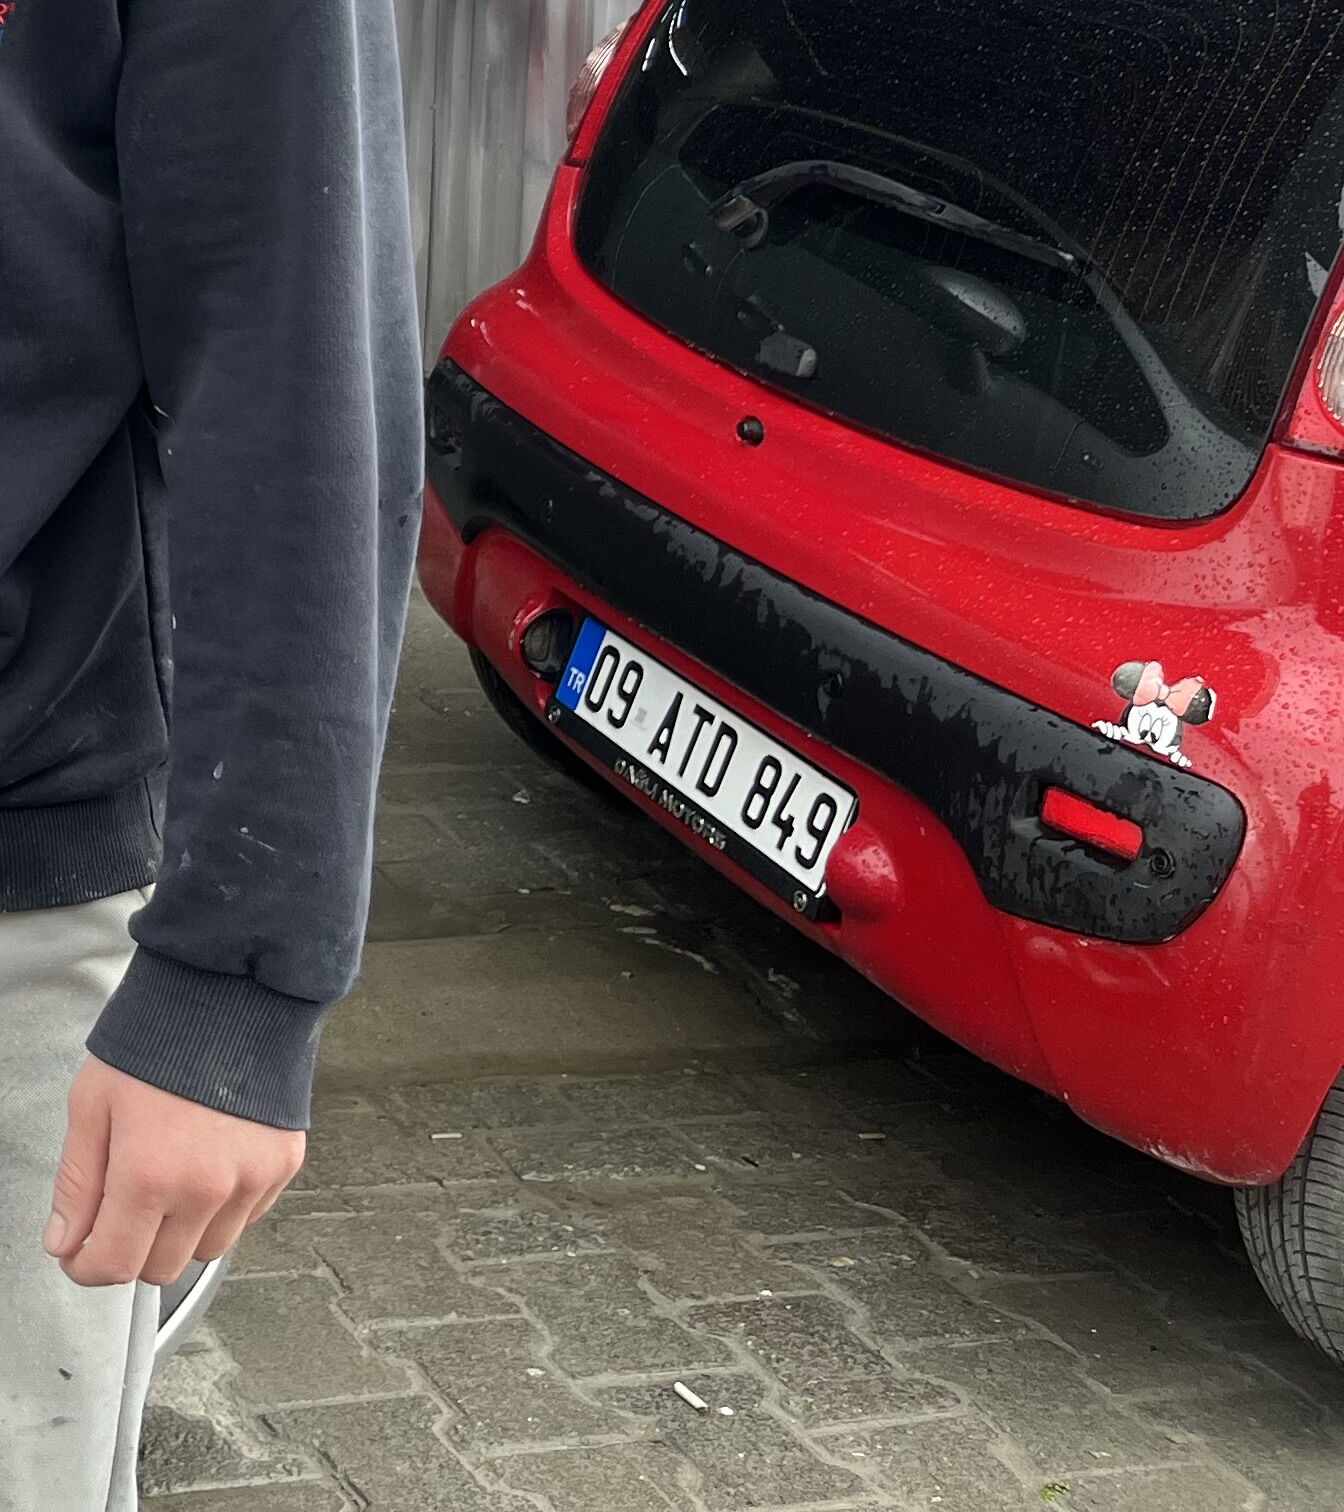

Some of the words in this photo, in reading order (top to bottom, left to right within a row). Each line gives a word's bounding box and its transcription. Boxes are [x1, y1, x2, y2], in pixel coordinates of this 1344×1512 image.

[567, 666, 587, 695] TR
[584, 645, 644, 729] 09
[647, 691, 739, 798] ATD
[741, 754, 838, 870] 849
